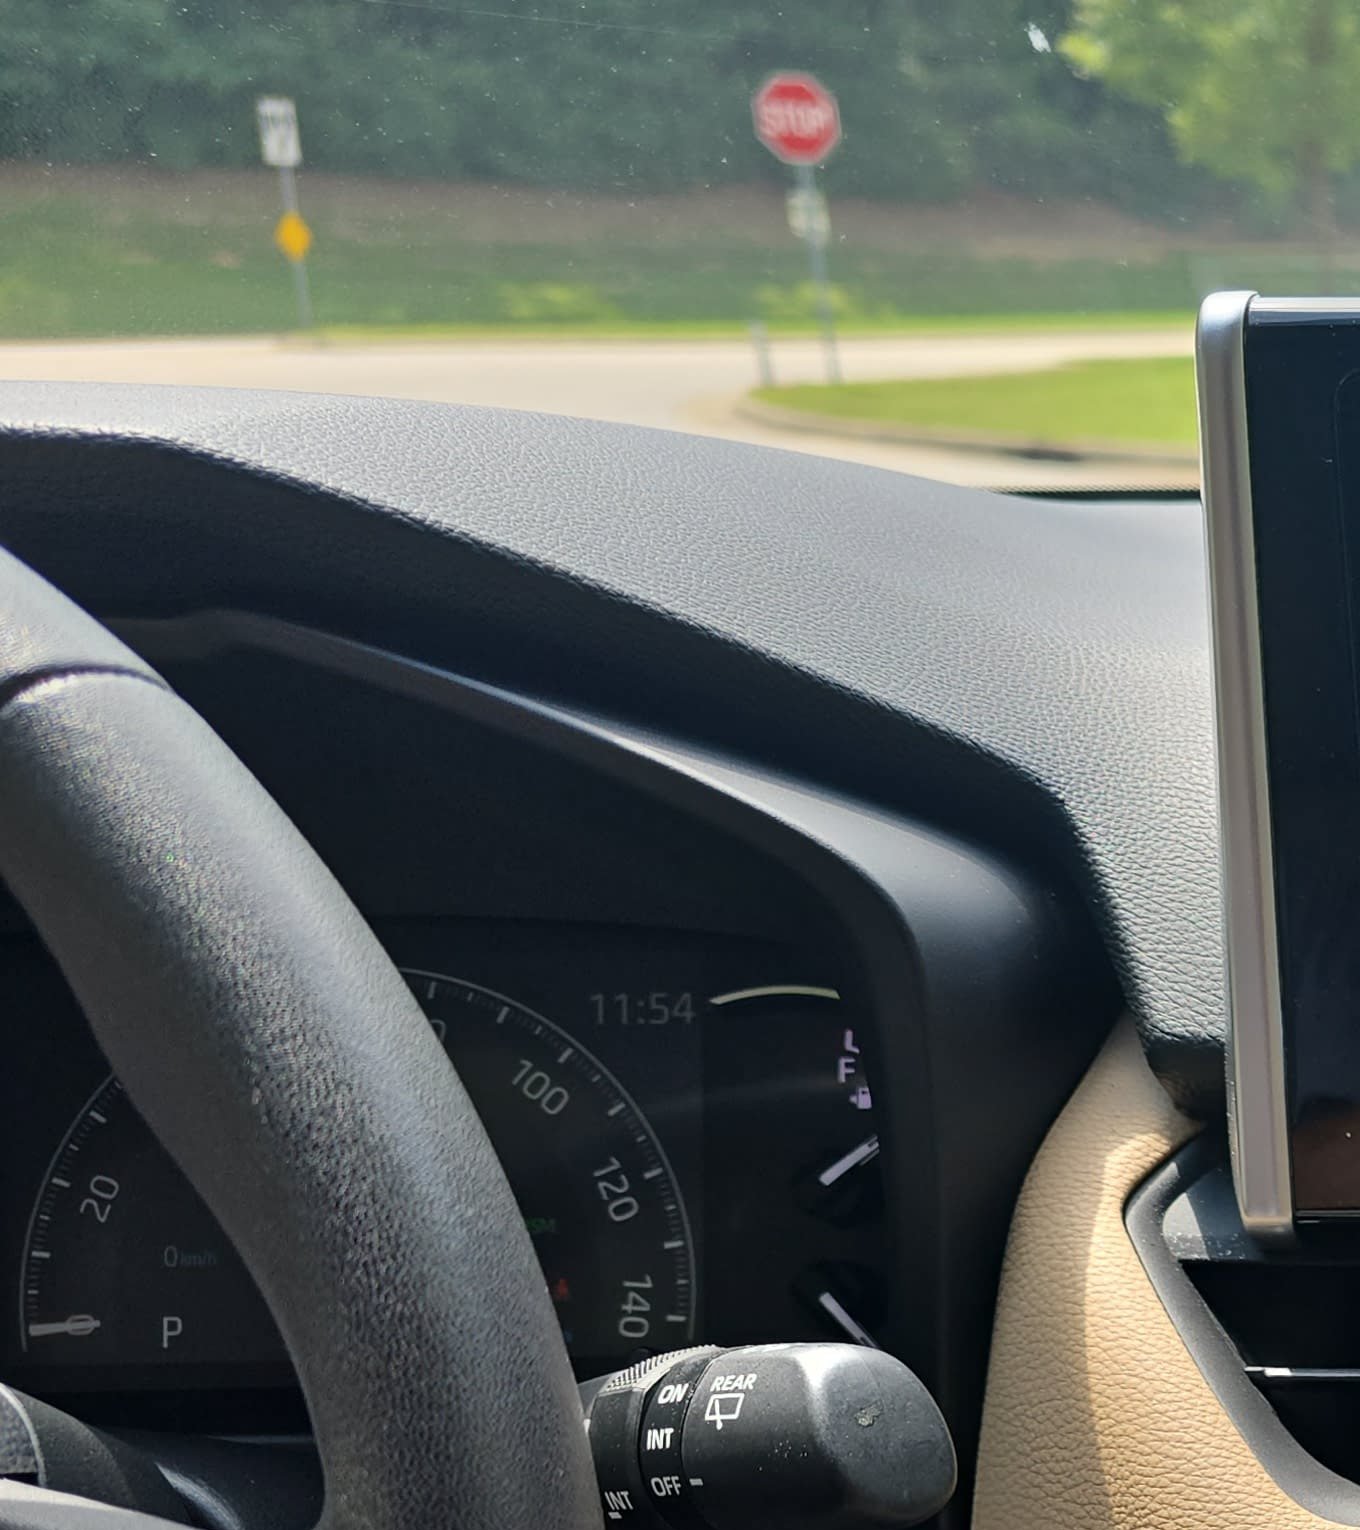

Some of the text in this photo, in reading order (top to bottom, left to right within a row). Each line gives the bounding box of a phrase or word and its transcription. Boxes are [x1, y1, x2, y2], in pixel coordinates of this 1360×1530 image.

[590, 993, 697, 1025] 11:54
[838, 1057, 856, 1083] F
[511, 1059, 570, 1116] 100
[79, 1174, 120, 1223] 20
[592, 1156, 640, 1222] 120
[618, 1273, 653, 1340] 140
[162, 1316, 183, 1349] P
[657, 1383, 690, 1405] ON
[710, 1373, 757, 1392] REAR
[646, 1428, 674, 1450] INT
[604, 1490, 634, 1511] INT
[650, 1475, 682, 1497] OFF
